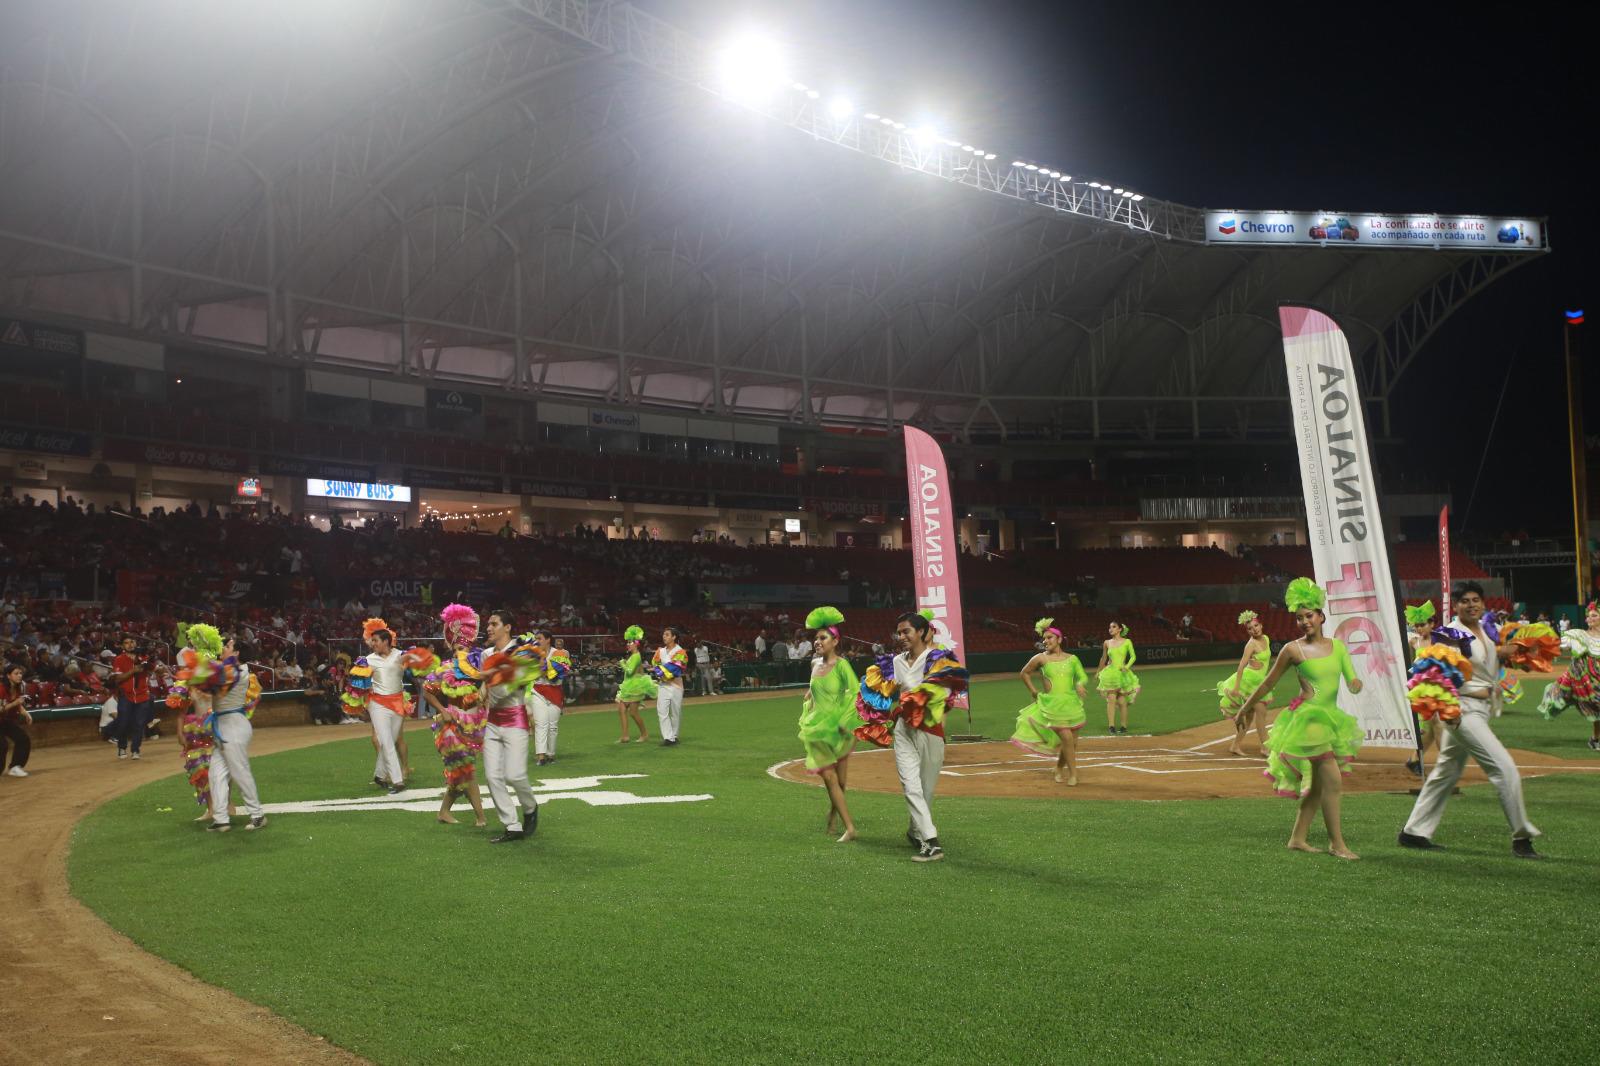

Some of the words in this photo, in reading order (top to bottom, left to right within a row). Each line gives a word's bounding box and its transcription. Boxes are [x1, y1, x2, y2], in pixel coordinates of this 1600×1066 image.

[1240, 219, 1295, 234] Chevron
[1370, 219, 1382, 229] La
[1385, 219, 1431, 230] confiaza
[1433, 220, 1446, 230] de
[1448, 220, 1485, 231] setirte
[1371, 230, 1429, 241] acompañado
[1431, 232, 1443, 240] en
[1444, 230, 1465, 240] cada
[1467, 232, 1486, 241] ruta
[325, 479, 362, 497] SUNNY
[367, 482, 395, 500] BUNS
